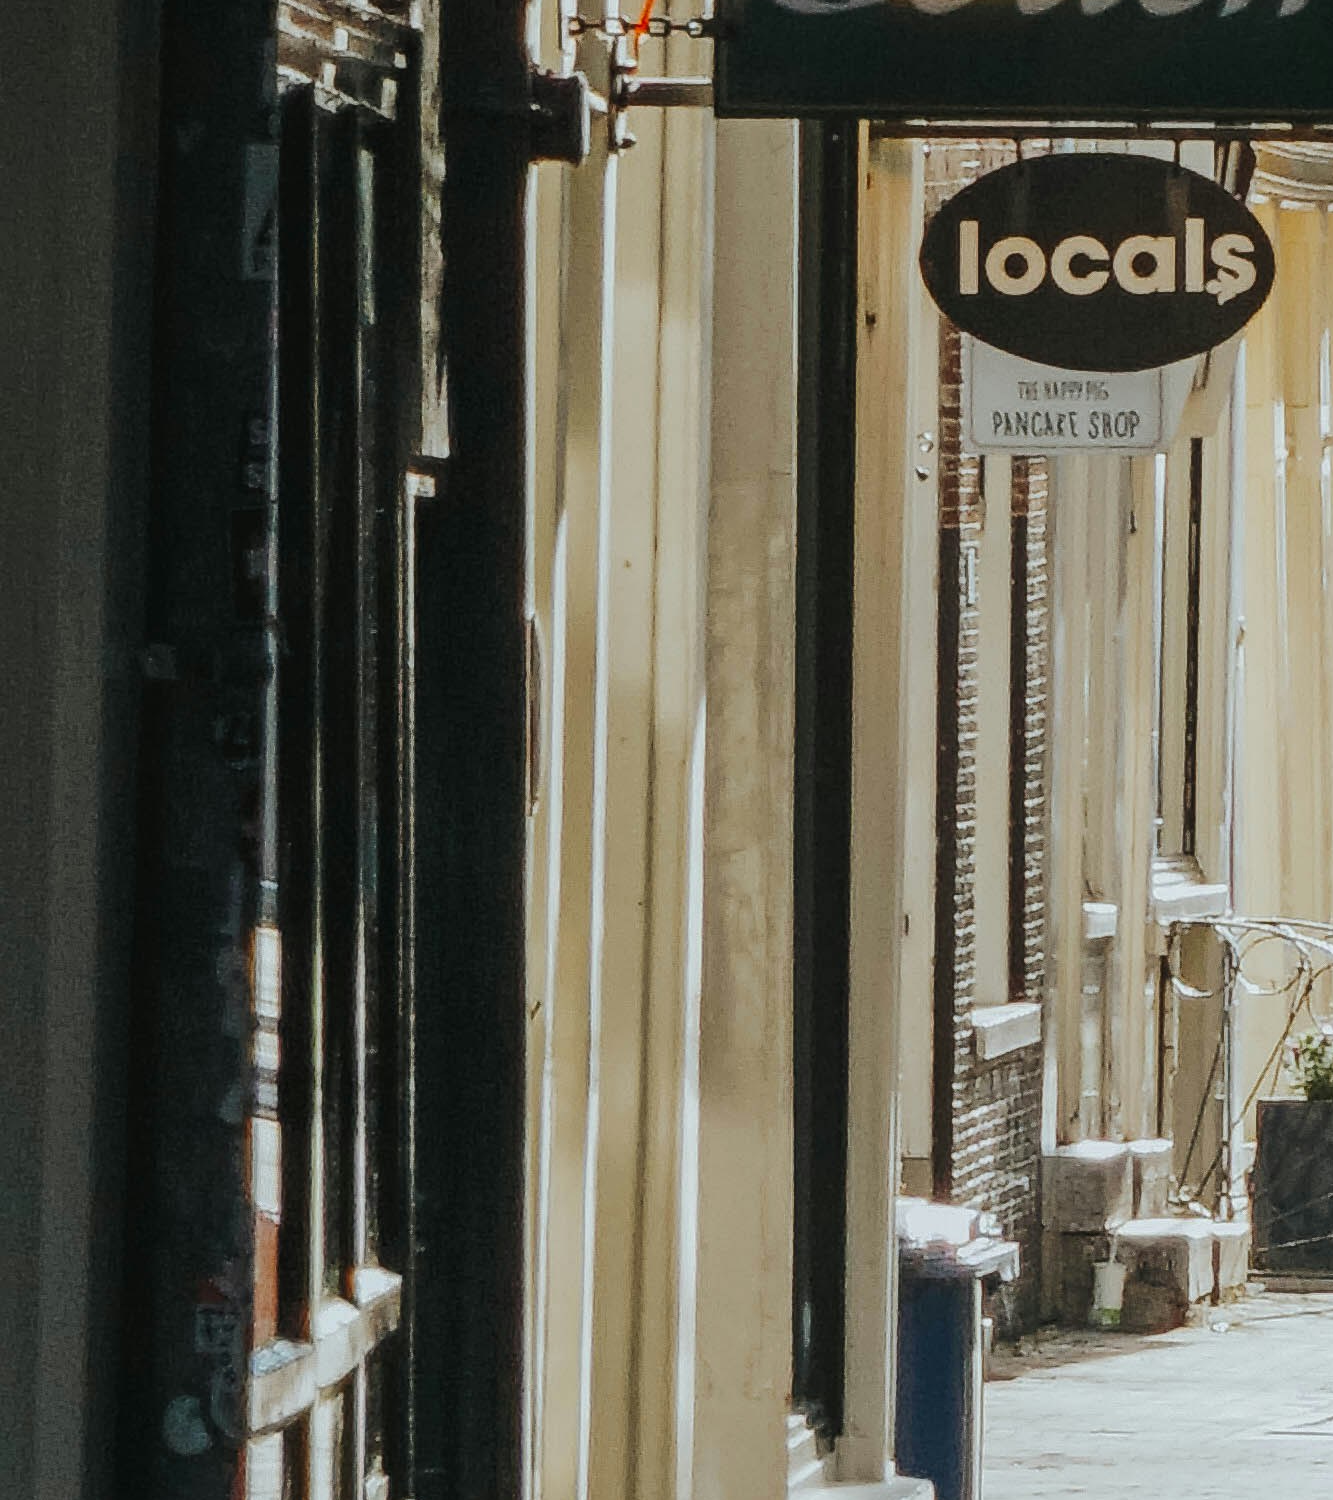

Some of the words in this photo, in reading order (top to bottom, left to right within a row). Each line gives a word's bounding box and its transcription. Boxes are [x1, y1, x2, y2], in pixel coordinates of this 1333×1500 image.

[959, 216, 1258, 305] locals
[992, 410, 1080, 439] PANCAKE
[1087, 409, 1141, 440] SHOP
